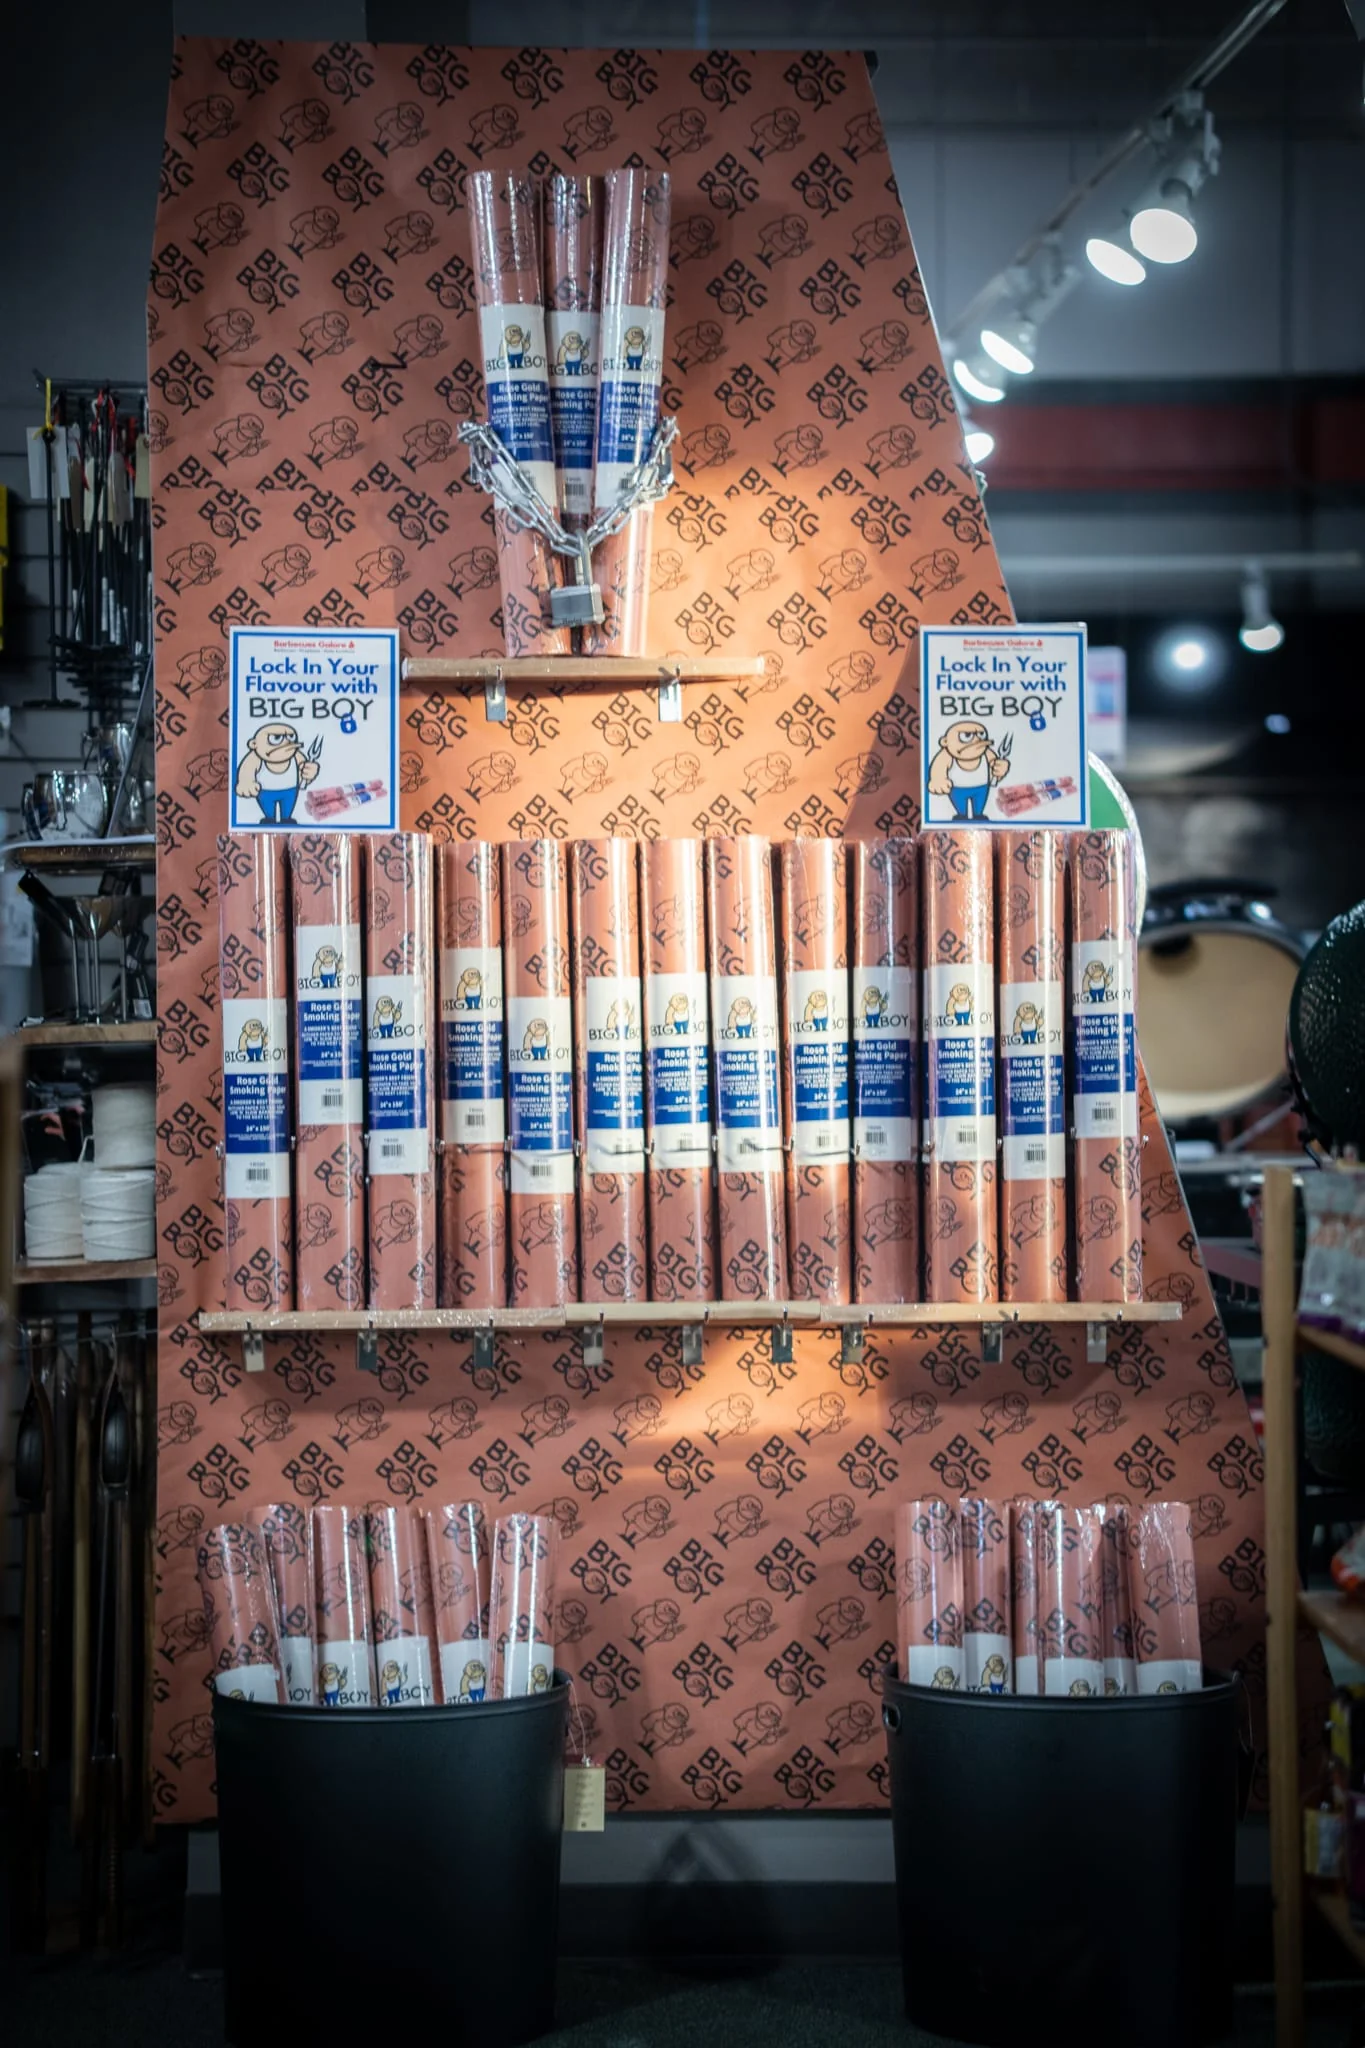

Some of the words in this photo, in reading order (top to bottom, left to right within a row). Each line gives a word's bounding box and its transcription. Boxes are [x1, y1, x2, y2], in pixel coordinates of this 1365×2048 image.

[234, 38, 280, 86] BIG
[519, 47, 565, 93] BIG
[801, 50, 847, 95] BIG
[226, 159, 276, 209] BOY
[243, 142, 290, 193] BIG
[321, 164, 371, 213] BOY
[339, 147, 385, 197] BIG
[714, 152, 760, 202] BIG
[698, 171, 745, 220] BOY
[332, 269, 380, 317] BOY
[349, 252, 395, 302] BIG
[816, 258, 862, 308] BIG
[799, 277, 847, 324] BOY
[168, 350, 215, 400] BIG
[264, 353, 311, 404] BIG
[486, 358, 505, 372] BIG
[499, 383, 519, 392] Rose
[521, 383, 540, 392] Gold
[150, 367, 200, 416] BOY
[246, 371, 295, 420] BOY
[555, 391, 576, 399] Rose
[806, 381, 854, 430] BOY
[823, 363, 869, 414] BIG
[293, 502, 342, 549] BOY
[310, 490, 357, 534] BIG
[758, 507, 804, 552] BOY
[776, 496, 820, 537] BIG
[396, 607, 444, 655] BOY
[414, 589, 459, 639] BIG
[674, 609, 721, 656] BOY
[692, 591, 736, 640] BIG
[246, 676, 325, 693] Flavour
[332, 678, 378, 694] with
[250, 657, 296, 674] Lock
[303, 658, 322, 674] In
[328, 658, 379, 675] Your
[936, 675, 1015, 691] Flavour
[1020, 676, 1066, 691] with
[940, 656, 986, 673] Lock
[993, 657, 1011, 672] In
[1017, 656, 1067, 673] Your
[250, 698, 304, 718] BIG
[312, 698, 373, 720] BOY
[607, 693, 652, 741] BIG
[791, 693, 836, 740] BIG
[940, 697, 994, 716] BIG
[1002, 696, 1062, 718] BOY
[591, 710, 638, 756] BOY
[775, 712, 821, 756] BOY
[222, 933, 264, 982] BIG
[298, 977, 319, 989] BIG
[1106, 988, 1131, 1002] BOY
[165, 1000, 210, 1047] BIG
[303, 1012, 339, 1022] Smoking
[311, 1003, 332, 1012] Rose
[455, 1024, 476, 1033] Rose
[651, 1024, 673, 1036] BIG
[880, 1014, 908, 1028] BOY
[1081, 1016, 1100, 1026] Rose
[394, 1024, 424, 1038] BOY
[589, 1028, 614, 1040] BIG
[665, 1049, 685, 1058] Rose
[803, 1046, 824, 1055] Rose
[877, 1042, 896, 1050] Gold
[945, 1040, 966, 1049] Rose
[1001, 1033, 1021, 1047] BIG
[1076, 1027, 1109, 1037] Smoking
[225, 1050, 246, 1063] BIG
[391, 1051, 412, 1060] Gold
[510, 1049, 531, 1061] BIG
[721, 1062, 755, 1072] Smoking
[727, 1053, 747, 1061] Rose
[884, 1051, 908, 1061] Paper
[938, 1050, 974, 1060] Smoking
[1012, 1059, 1033, 1068] Rose
[230, 1086, 265, 1096] Smoking
[236, 1076, 257, 1085] Rose
[515, 1084, 549, 1094] Smoking
[522, 1074, 541, 1083] Rose
[156, 1119, 203, 1166] BOY
[173, 1102, 217, 1150] BIG
[657, 1242, 697, 1291] BIG
[205, 1443, 251, 1491] BIG
[376, 1458, 423, 1504] BOY
[393, 1440, 439, 1488] BIG
[561, 1455, 609, 1501] BOY
[579, 1437, 624, 1485] BIG
[746, 1452, 793, 1499] BOY
[763, 1435, 807, 1483] BIG
[1021, 1451, 1069, 1497] BOY
[1038, 1434, 1083, 1482] BIG
[1114, 1451, 1162, 1498] BOY
[1131, 1434, 1177, 1482] BIG
[188, 1462, 235, 1508] BOY
[663, 1556, 710, 1603] BOY
[680, 1538, 725, 1587] BIG
[579, 1661, 627, 1709] BOY
[596, 1643, 641, 1692] BIG
[764, 1659, 812, 1706] BOY
[782, 1641, 827, 1689] BIG
[340, 1691, 369, 1704] BOY
[400, 1687, 431, 1701] BOY
[681, 1765, 729, 1811] BOY
[698, 1747, 743, 1794] BIG
